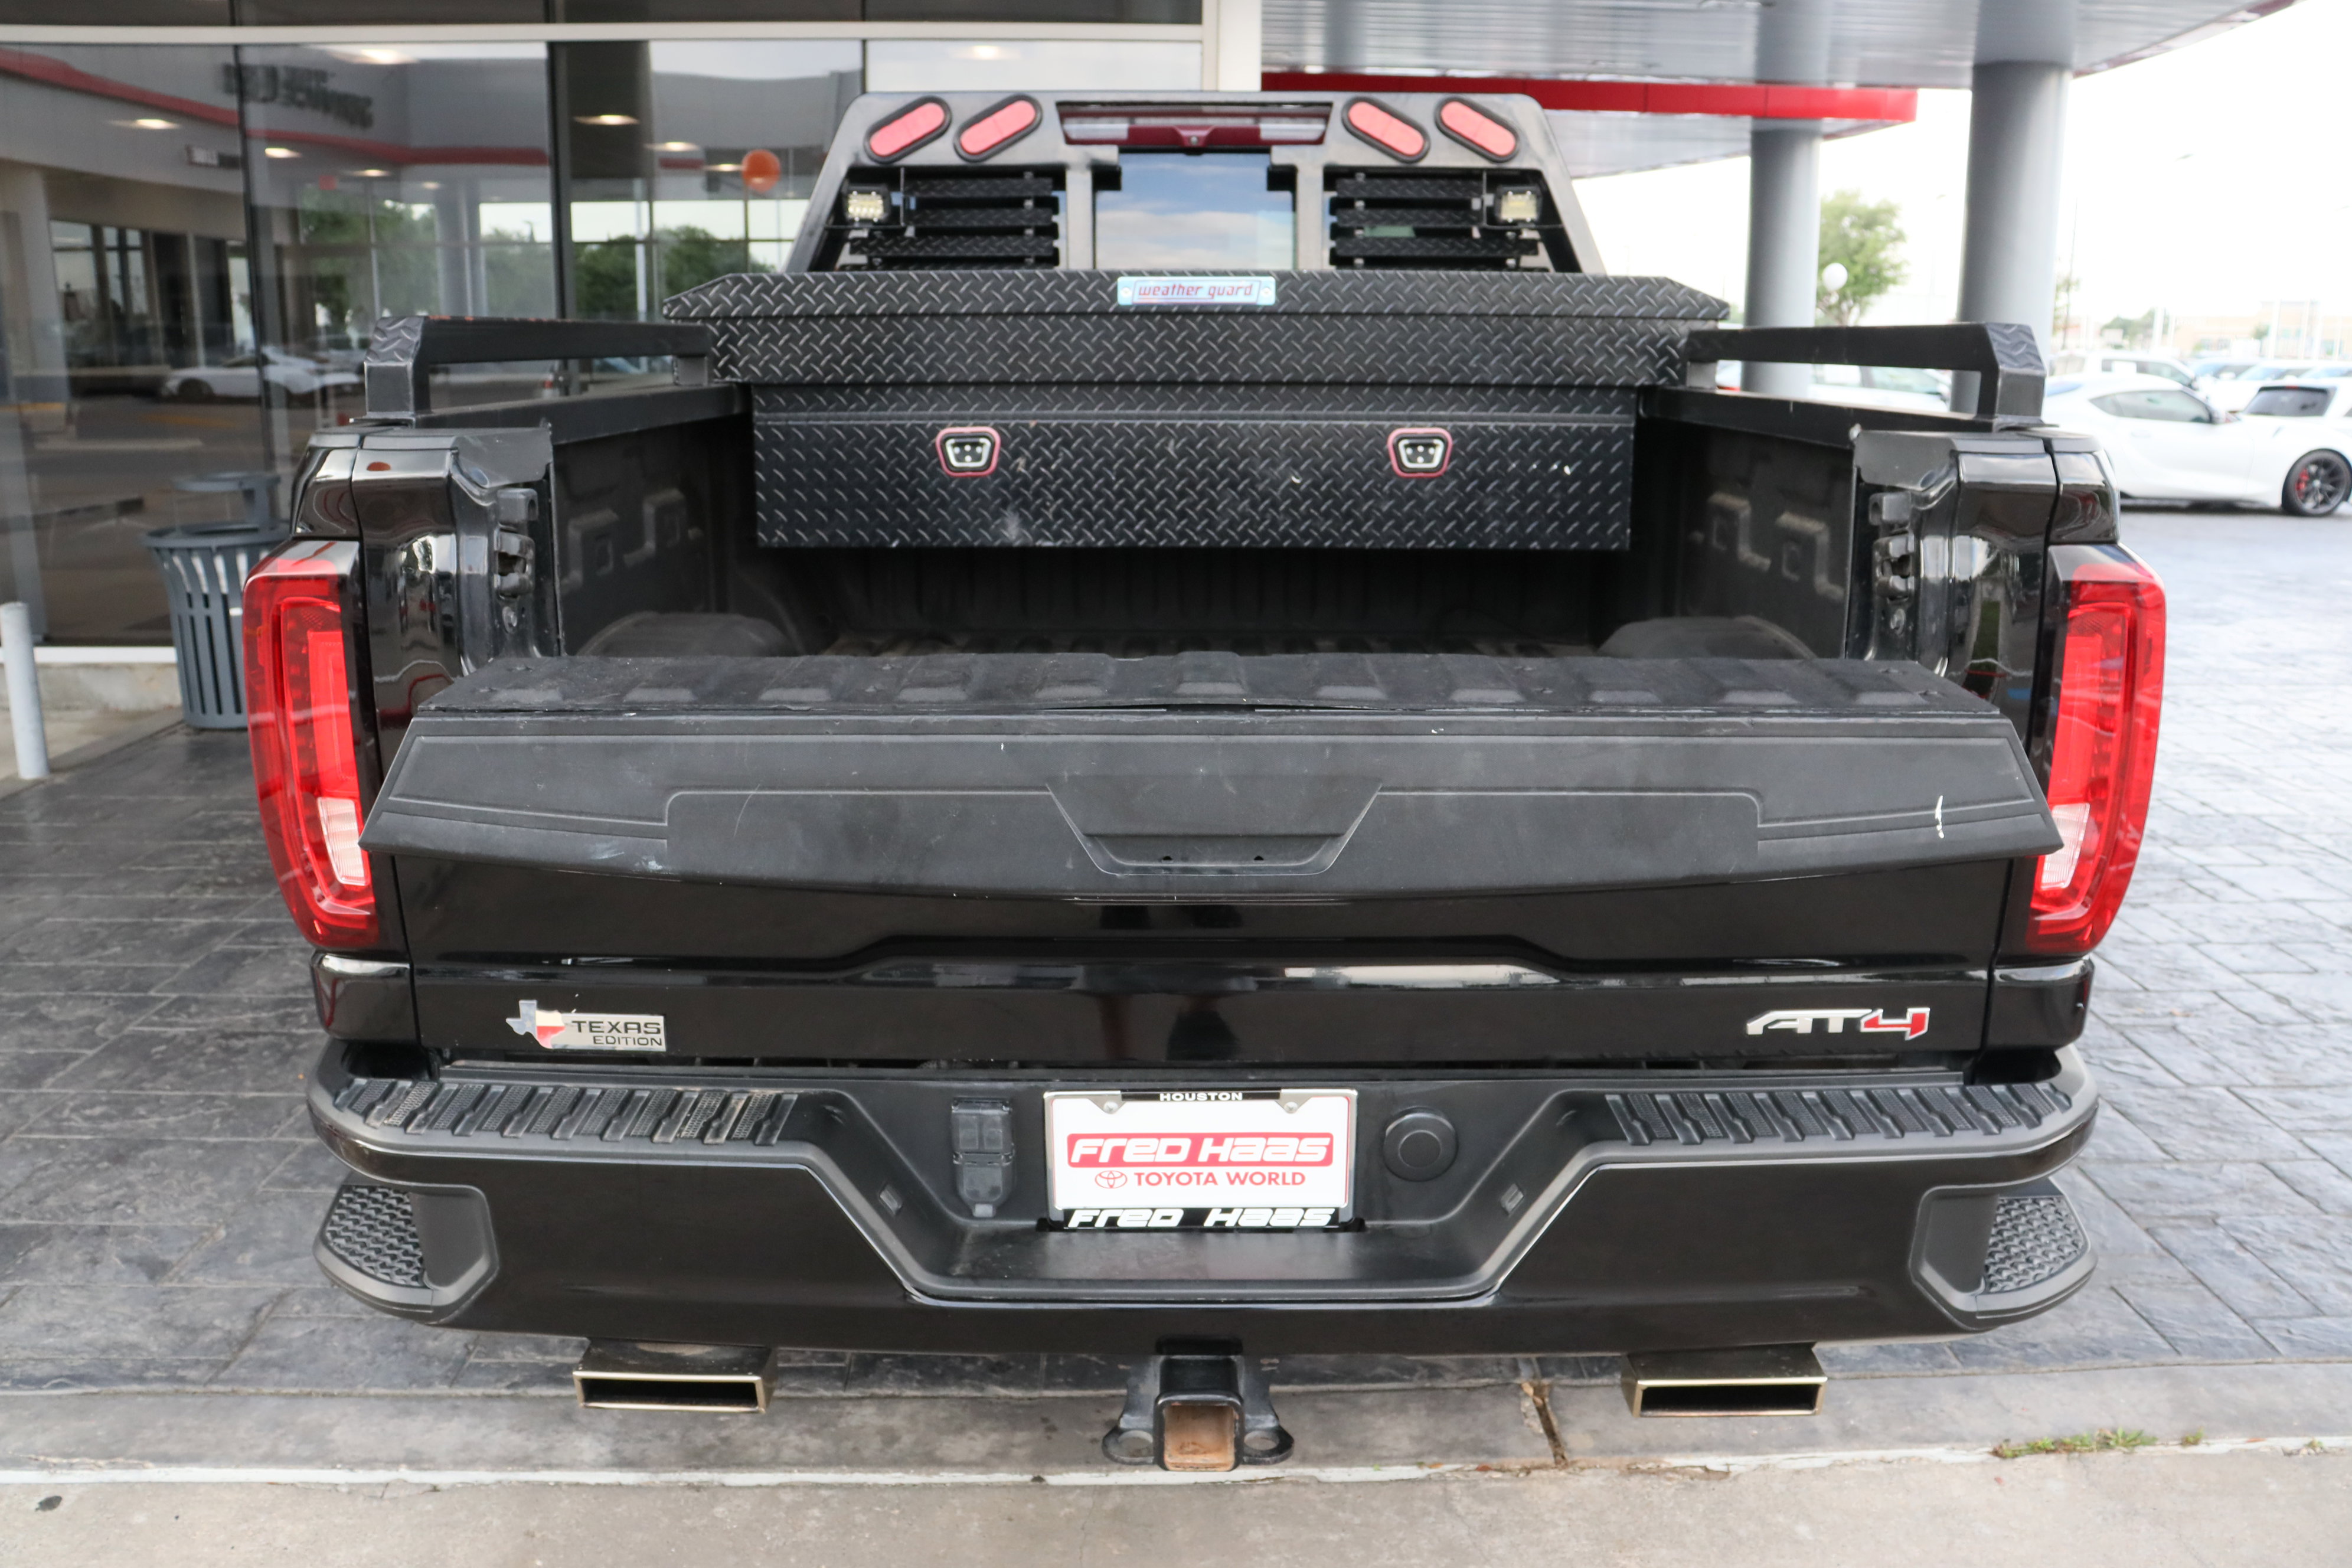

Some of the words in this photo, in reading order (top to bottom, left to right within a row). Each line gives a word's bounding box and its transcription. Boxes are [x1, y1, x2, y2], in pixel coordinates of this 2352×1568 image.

[1138, 283, 1203, 296] weather
[1208, 283, 1253, 299] guard
[571, 1020, 661, 1035] TEXAS
[1746, 1007, 1930, 1041] AT4
[593, 1035, 662, 1046] EDITION
[1159, 1092, 1243, 1102] HOUSTON
[1133, 1172, 1219, 1187] TOYOTA
[1226, 1171, 1306, 1185] WORLD
